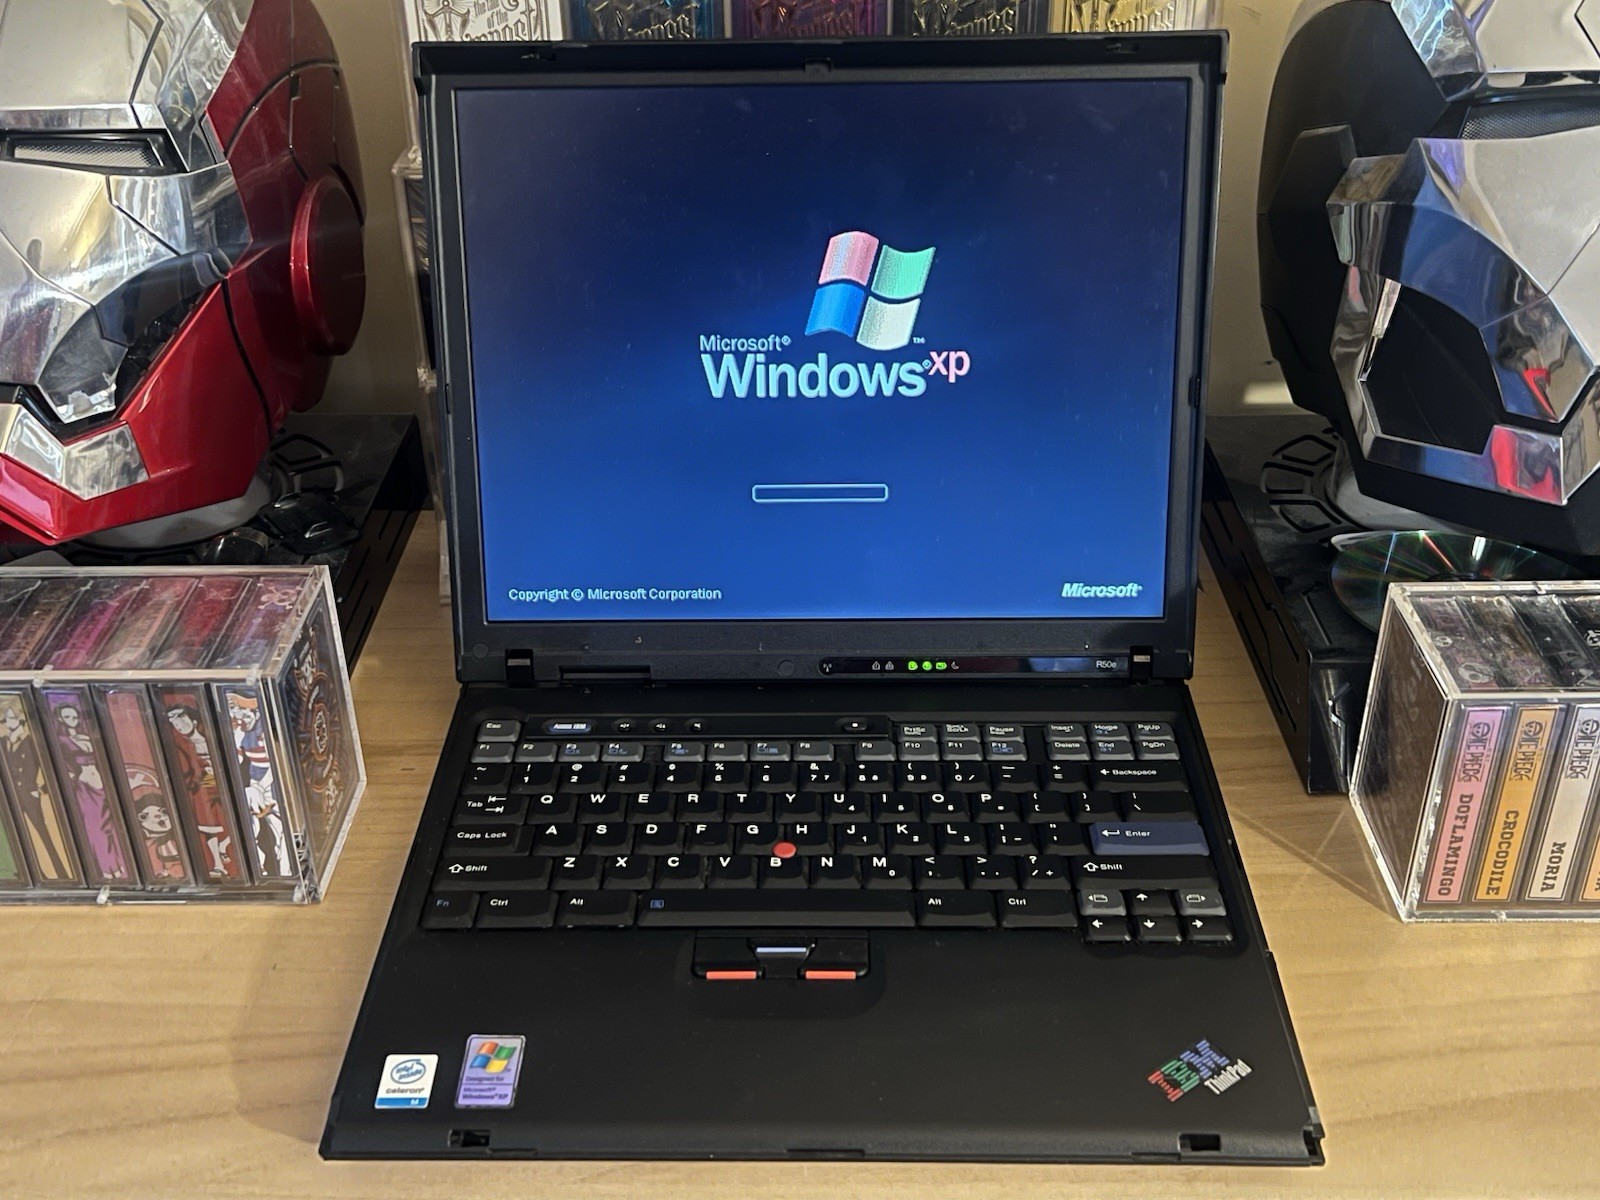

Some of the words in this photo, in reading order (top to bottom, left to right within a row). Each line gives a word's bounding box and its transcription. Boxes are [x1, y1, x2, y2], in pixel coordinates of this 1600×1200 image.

[508, 588, 570, 602] Copyright
[587, 588, 647, 601] Microsoft
[649, 587, 722, 602] Corporation
[1095, 660, 1117, 669] R50e
[479, 743, 490, 751] F1
[1112, 768, 1158, 777] Backspace
[540, 794, 554, 804] Q
[590, 793, 607, 804] W
[637, 793, 650, 804] E
[687, 793, 699, 804] R
[736, 793, 748, 803] T
[785, 793, 796, 803] Y
[833, 793, 845, 804] U
[931, 793, 945, 803] O
[980, 793, 992, 803] P
[467, 800, 484, 808] Tab
[545, 824, 558, 835] A
[595, 824, 608, 835] S
[645, 823, 658, 834] D
[696, 824, 708, 834] F
[746, 824, 759, 835] G
[796, 824, 808, 835] H
[846, 824, 856, 835] J
[896, 823, 909, 835] K
[946, 824, 958, 835] L
[456, 831, 482, 840] Caps
[484, 831, 507, 839] Lock
[1438, 793, 1474, 896] DOFLAMINGO
[1486, 810, 1520, 896] CROCODILE
[563, 856, 576, 868] Z
[615, 856, 628, 868] X
[667, 856, 680, 867] C
[719, 856, 731, 868] V
[769, 856, 782, 868] B
[821, 856, 833, 868] N
[872, 856, 887, 868] M
[1100, 862, 1123, 871] Shift
[1540, 842, 1567, 892] MORIA
[464, 864, 488, 873] Shift
[490, 898, 509, 906] Ctrl
[569, 898, 584, 906] Alt
[927, 897, 942, 906] Alt
[1008, 897, 1027, 906] Ctrl
[1148, 1039, 1230, 1102] IBM
